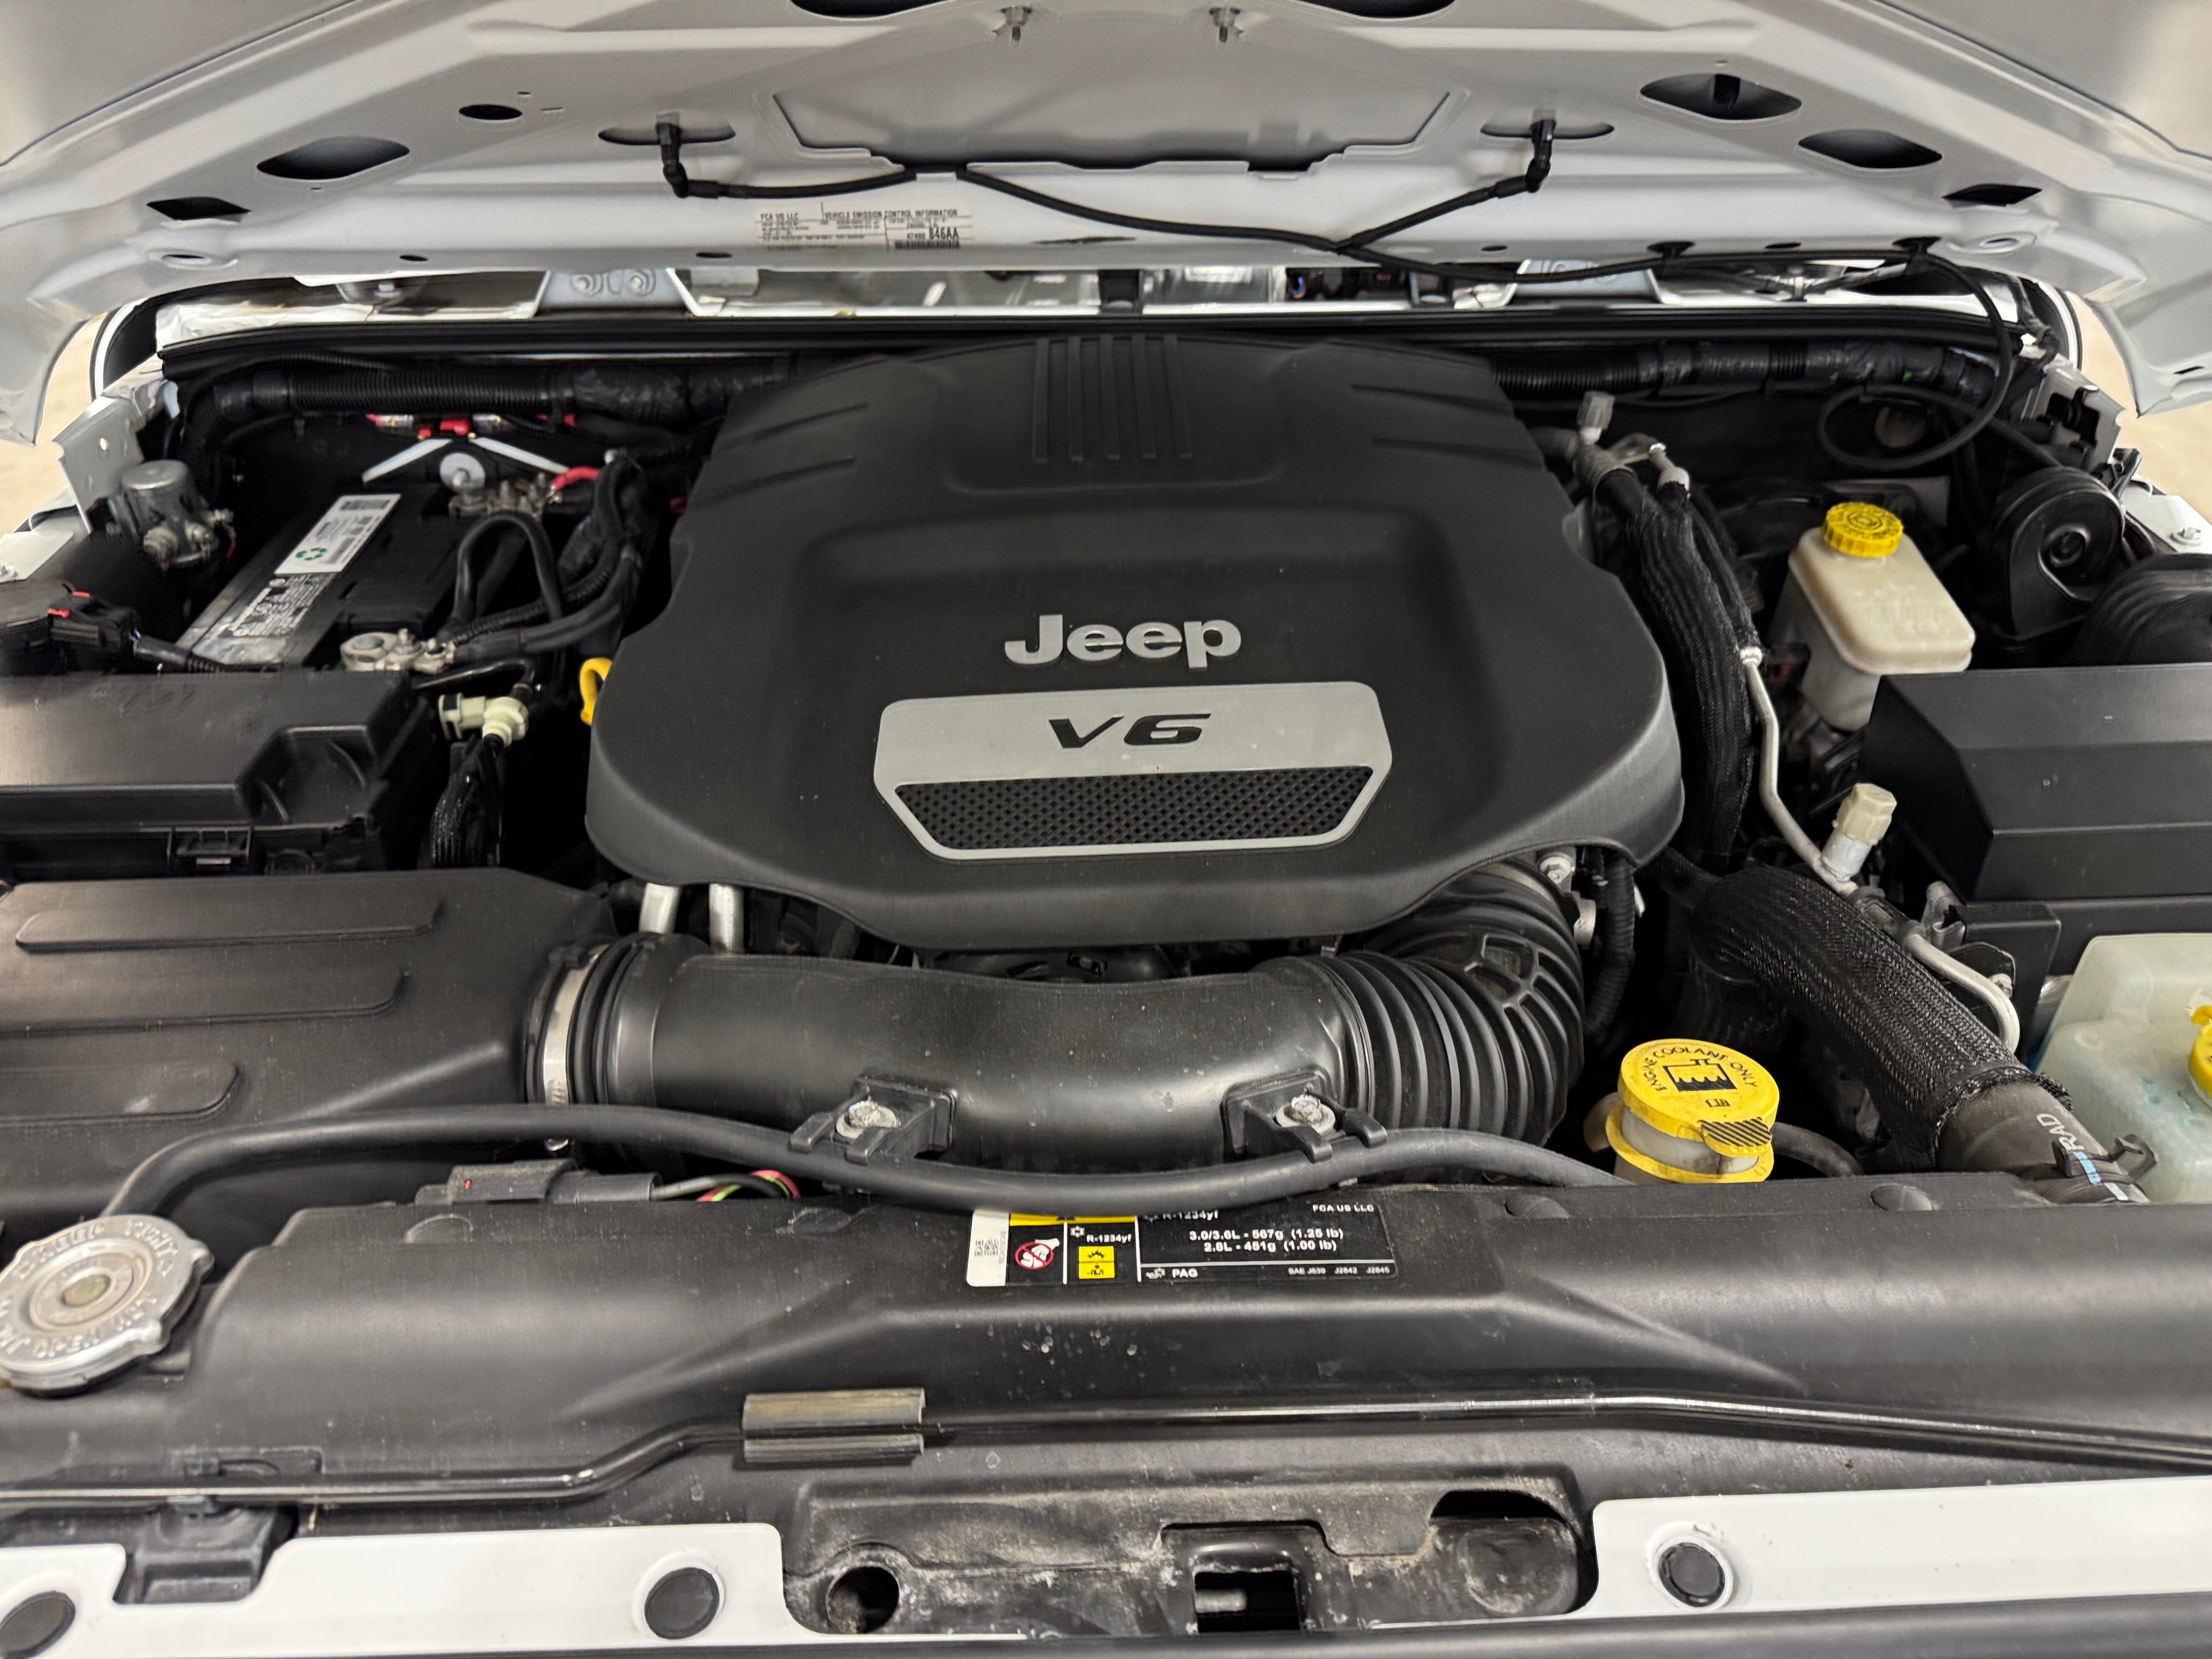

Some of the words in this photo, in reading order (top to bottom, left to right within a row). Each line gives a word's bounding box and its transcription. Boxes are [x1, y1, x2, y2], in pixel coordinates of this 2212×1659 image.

[825, 211, 850, 220] VEHICLE
[853, 210, 882, 219] EMISSION
[885, 210, 911, 218] CONTROL
[915, 209, 958, 217] INFORMATION
[1005, 614, 1242, 669] Jeep
[1048, 713, 1211, 749] V6
[1653, 1047, 1729, 1060] COOLANT
[1643, 1057, 1667, 1092] ENGINE
[1730, 1062, 1758, 1088] ONLY
[2036, 1113, 2085, 1151] RAD
[1312, 1204, 1334, 1212] FCA
[1353, 1204, 1375, 1212] LLC
[1086, 1233, 1132, 1244] R-1234yf
[1189, 1229, 1241, 1241] 3.0/3.6L
[1252, 1229, 1284, 1241] 567g
[1291, 1228, 1323, 1240] (1.25
[1326, 1228, 1344, 1240] lb)
[1284, 1240, 1316, 1252] (1.00
[1319, 1240, 1337, 1252] lb)
[1172, 1268, 1199, 1278] PAG
